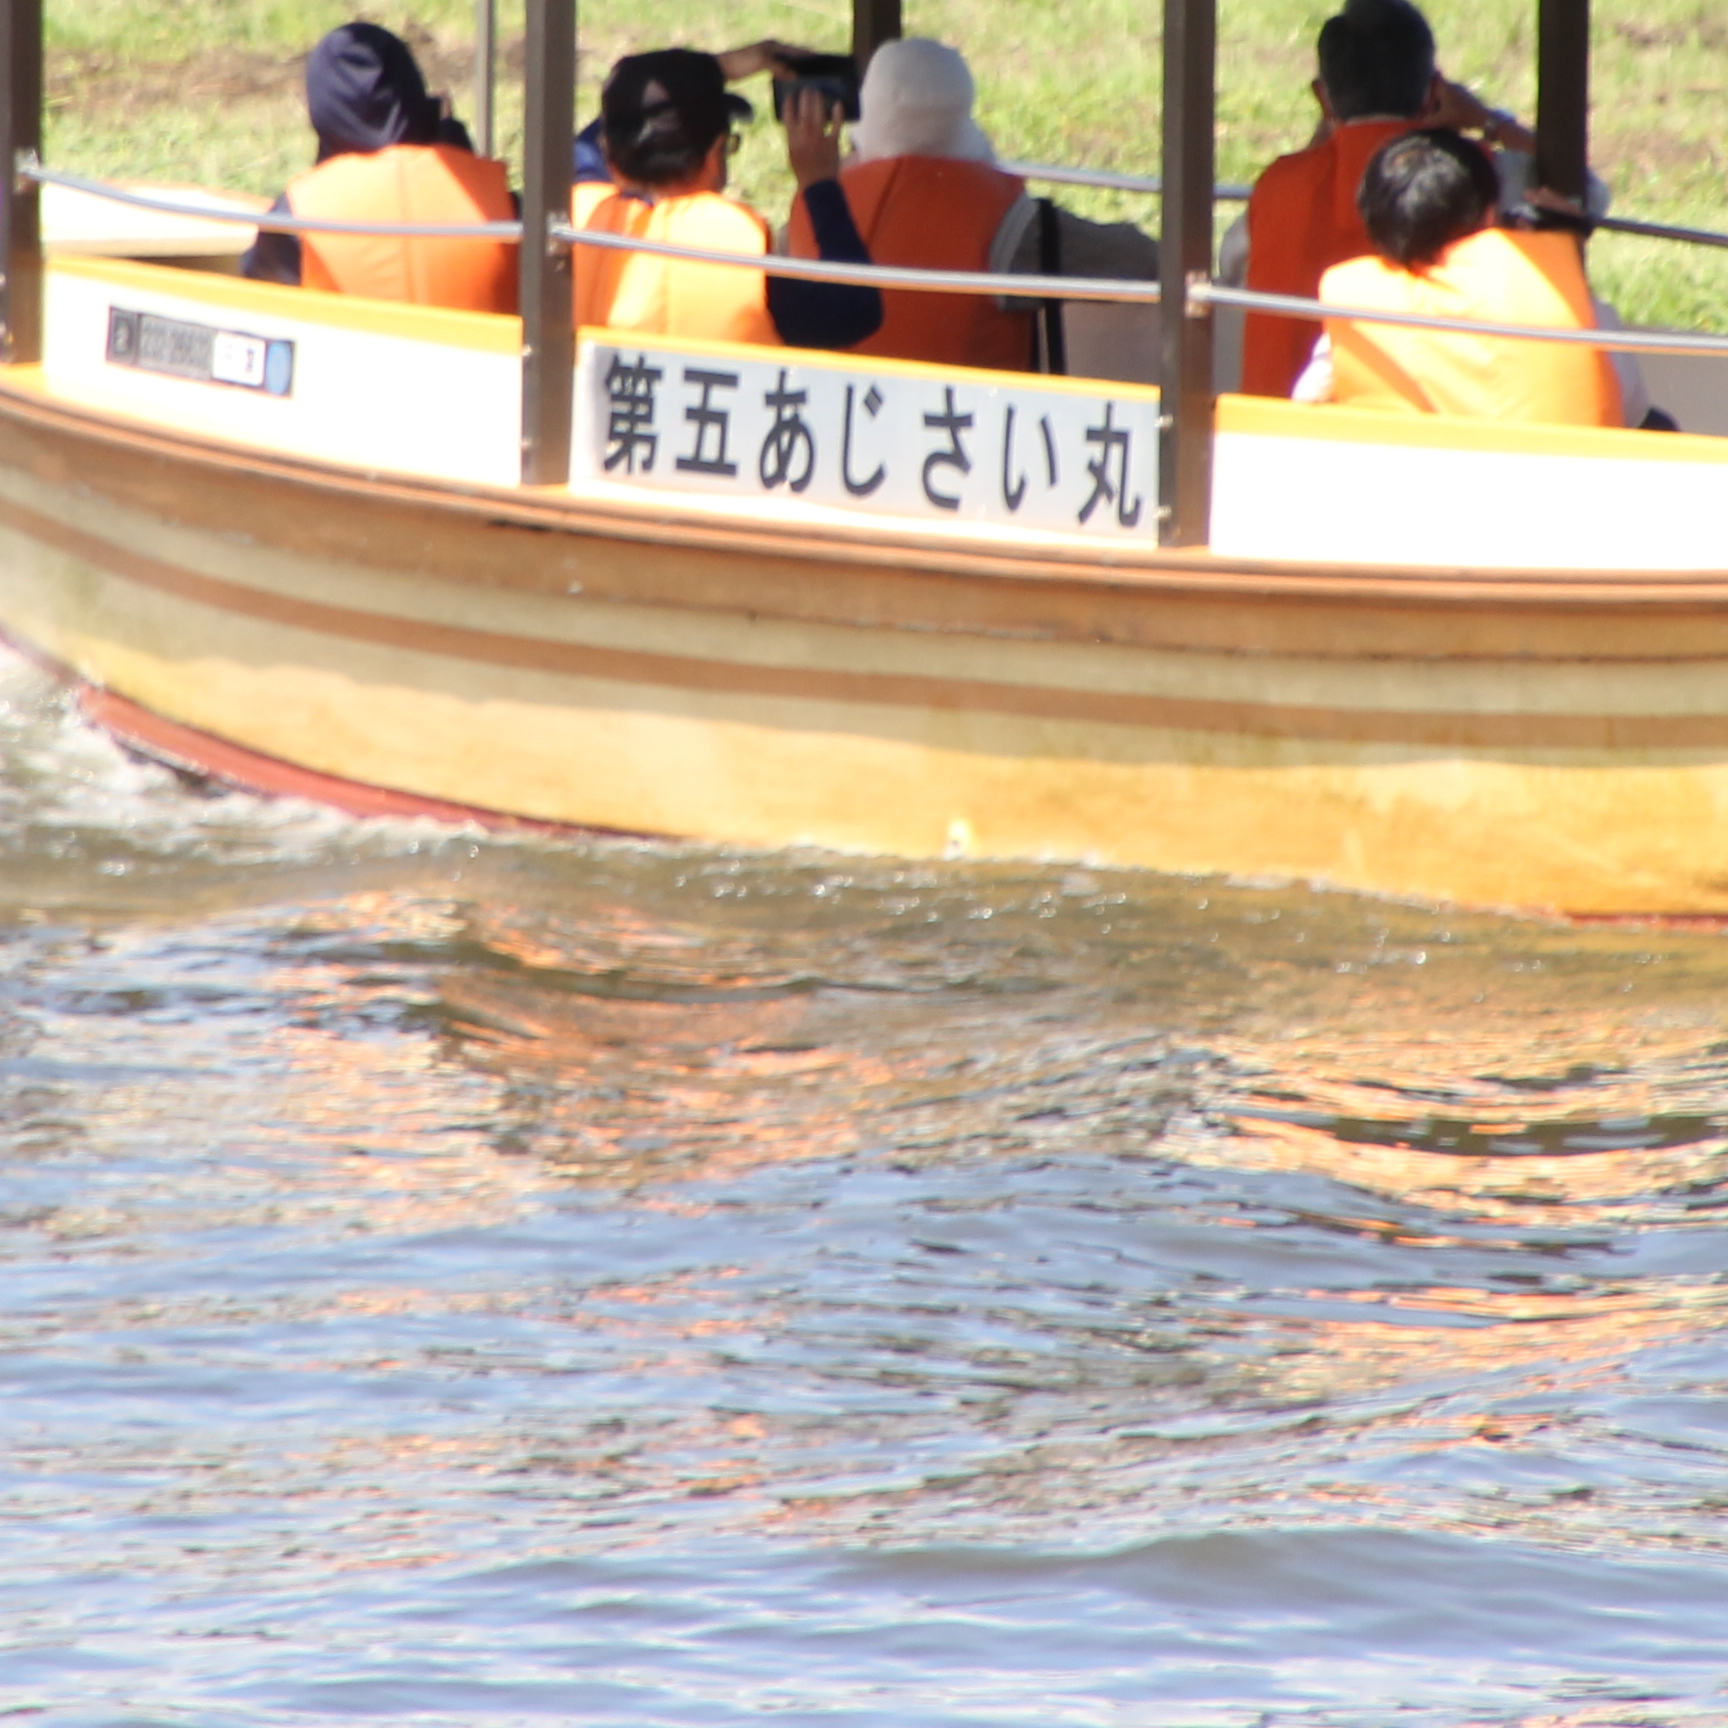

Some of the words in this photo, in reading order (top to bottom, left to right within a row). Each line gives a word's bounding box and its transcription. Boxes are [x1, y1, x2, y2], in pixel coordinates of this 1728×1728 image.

[603, 352, 1142, 528] 第五あじさい丸
